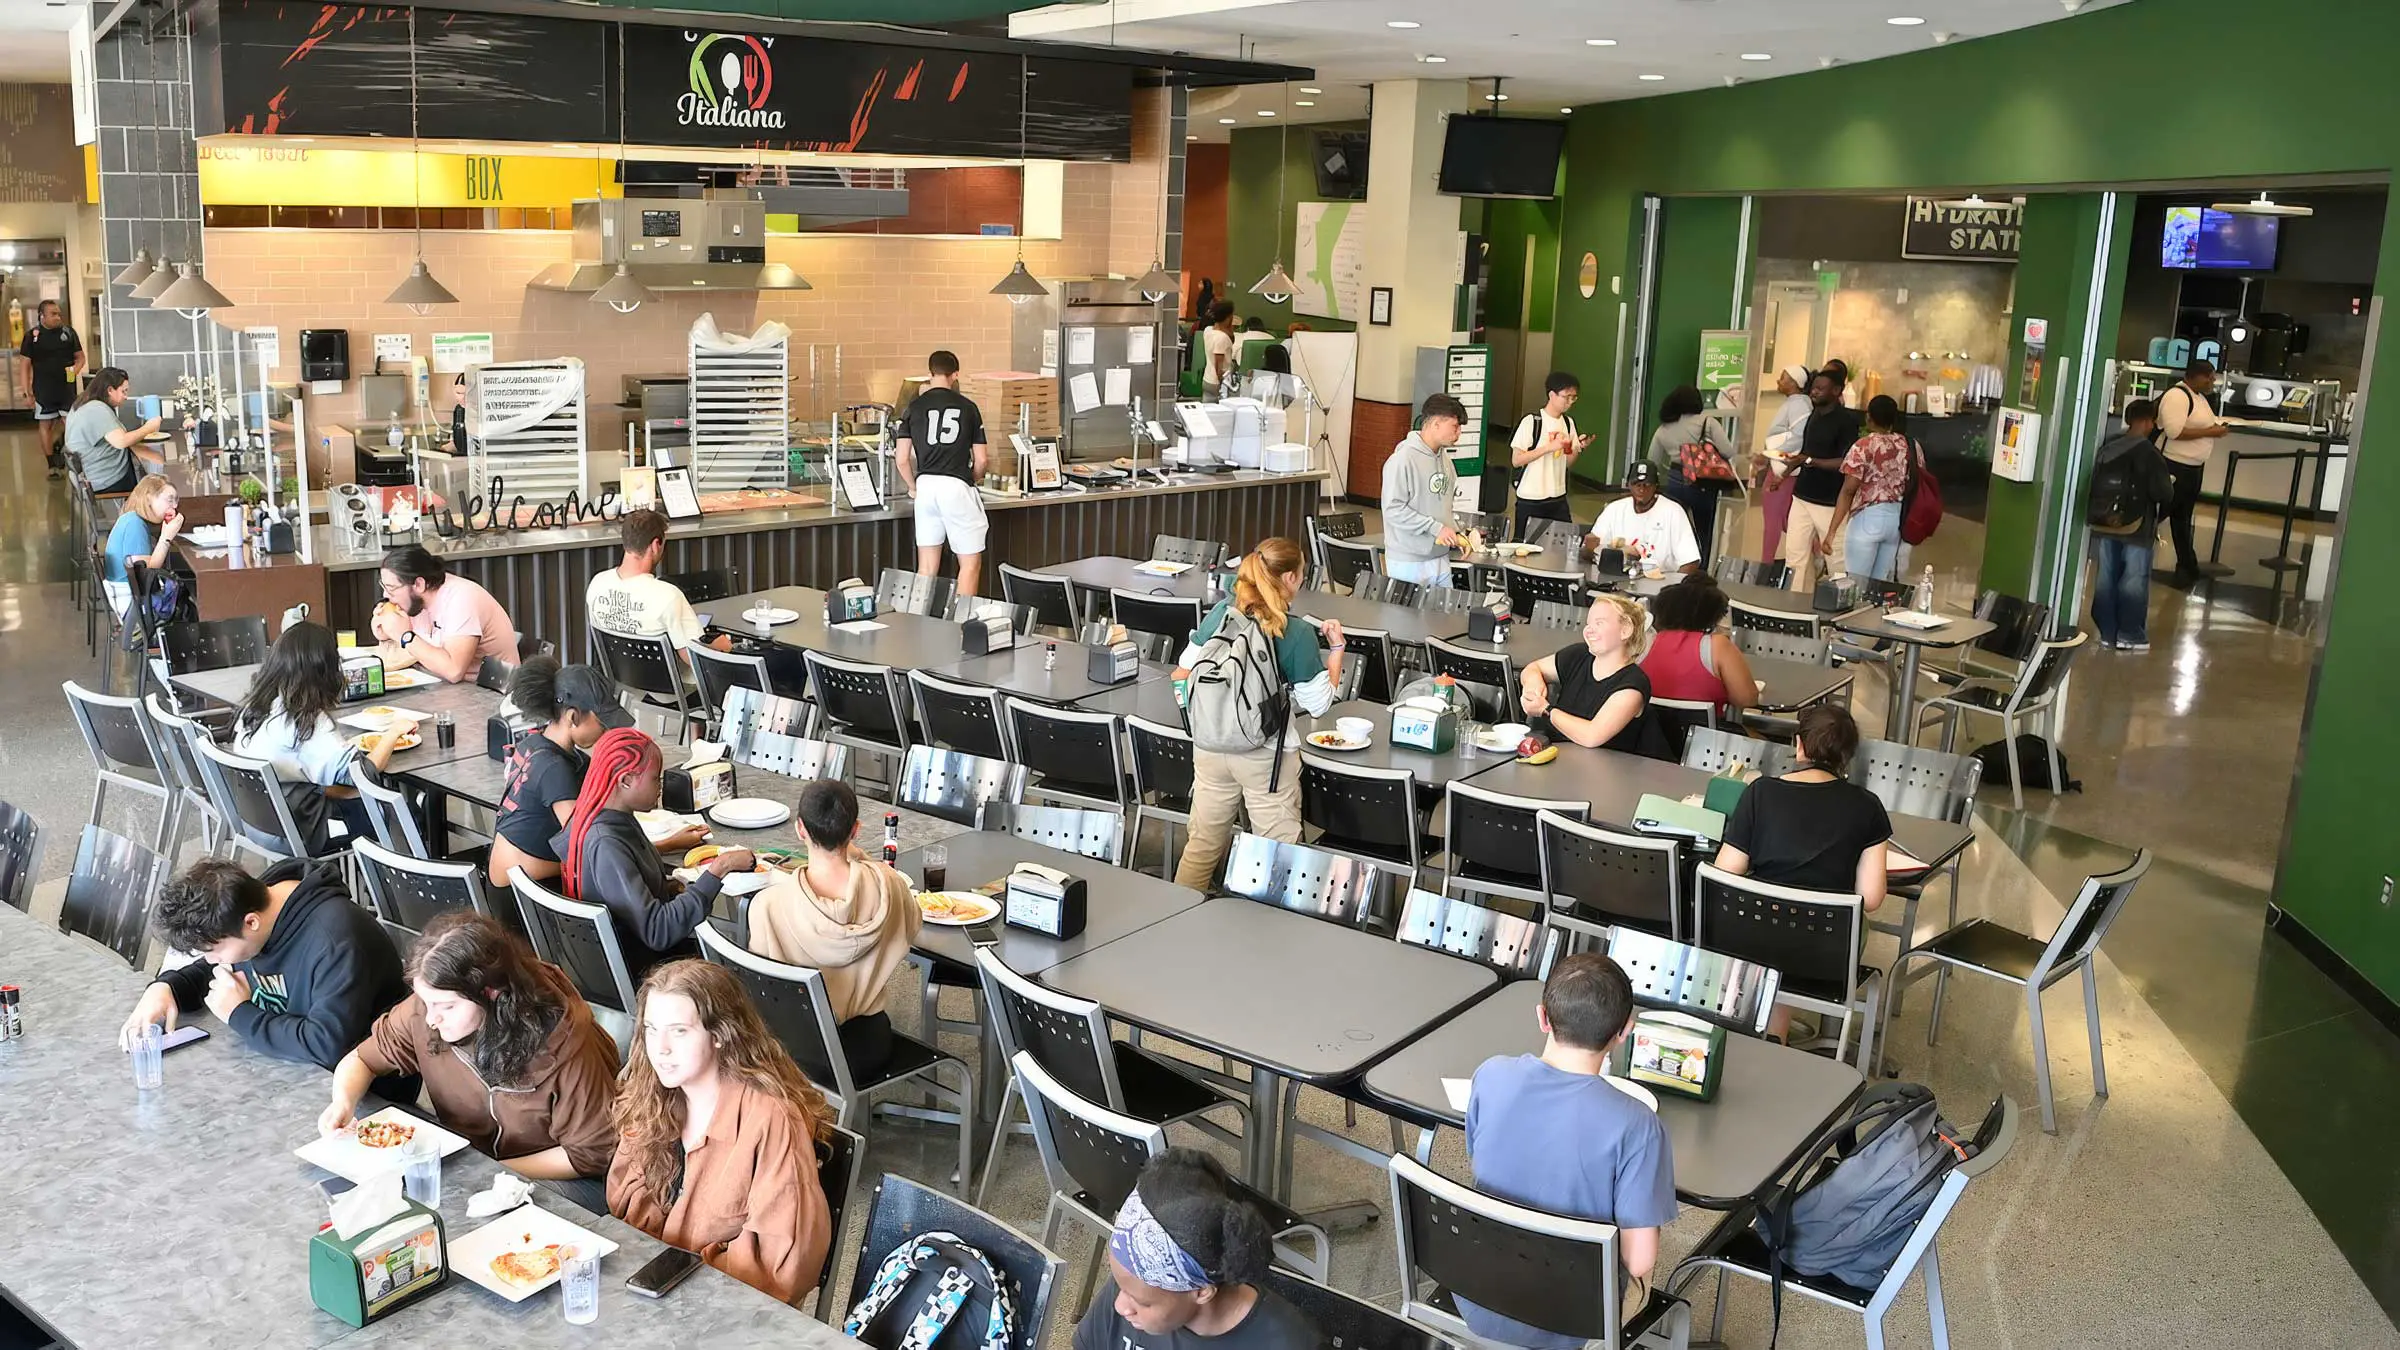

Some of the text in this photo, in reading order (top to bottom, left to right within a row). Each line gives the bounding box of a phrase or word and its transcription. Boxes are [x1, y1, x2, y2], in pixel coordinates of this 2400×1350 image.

[676, 92, 786, 129] Italiana
[466, 156, 504, 201] BOX
[927, 408, 961, 445] 15
